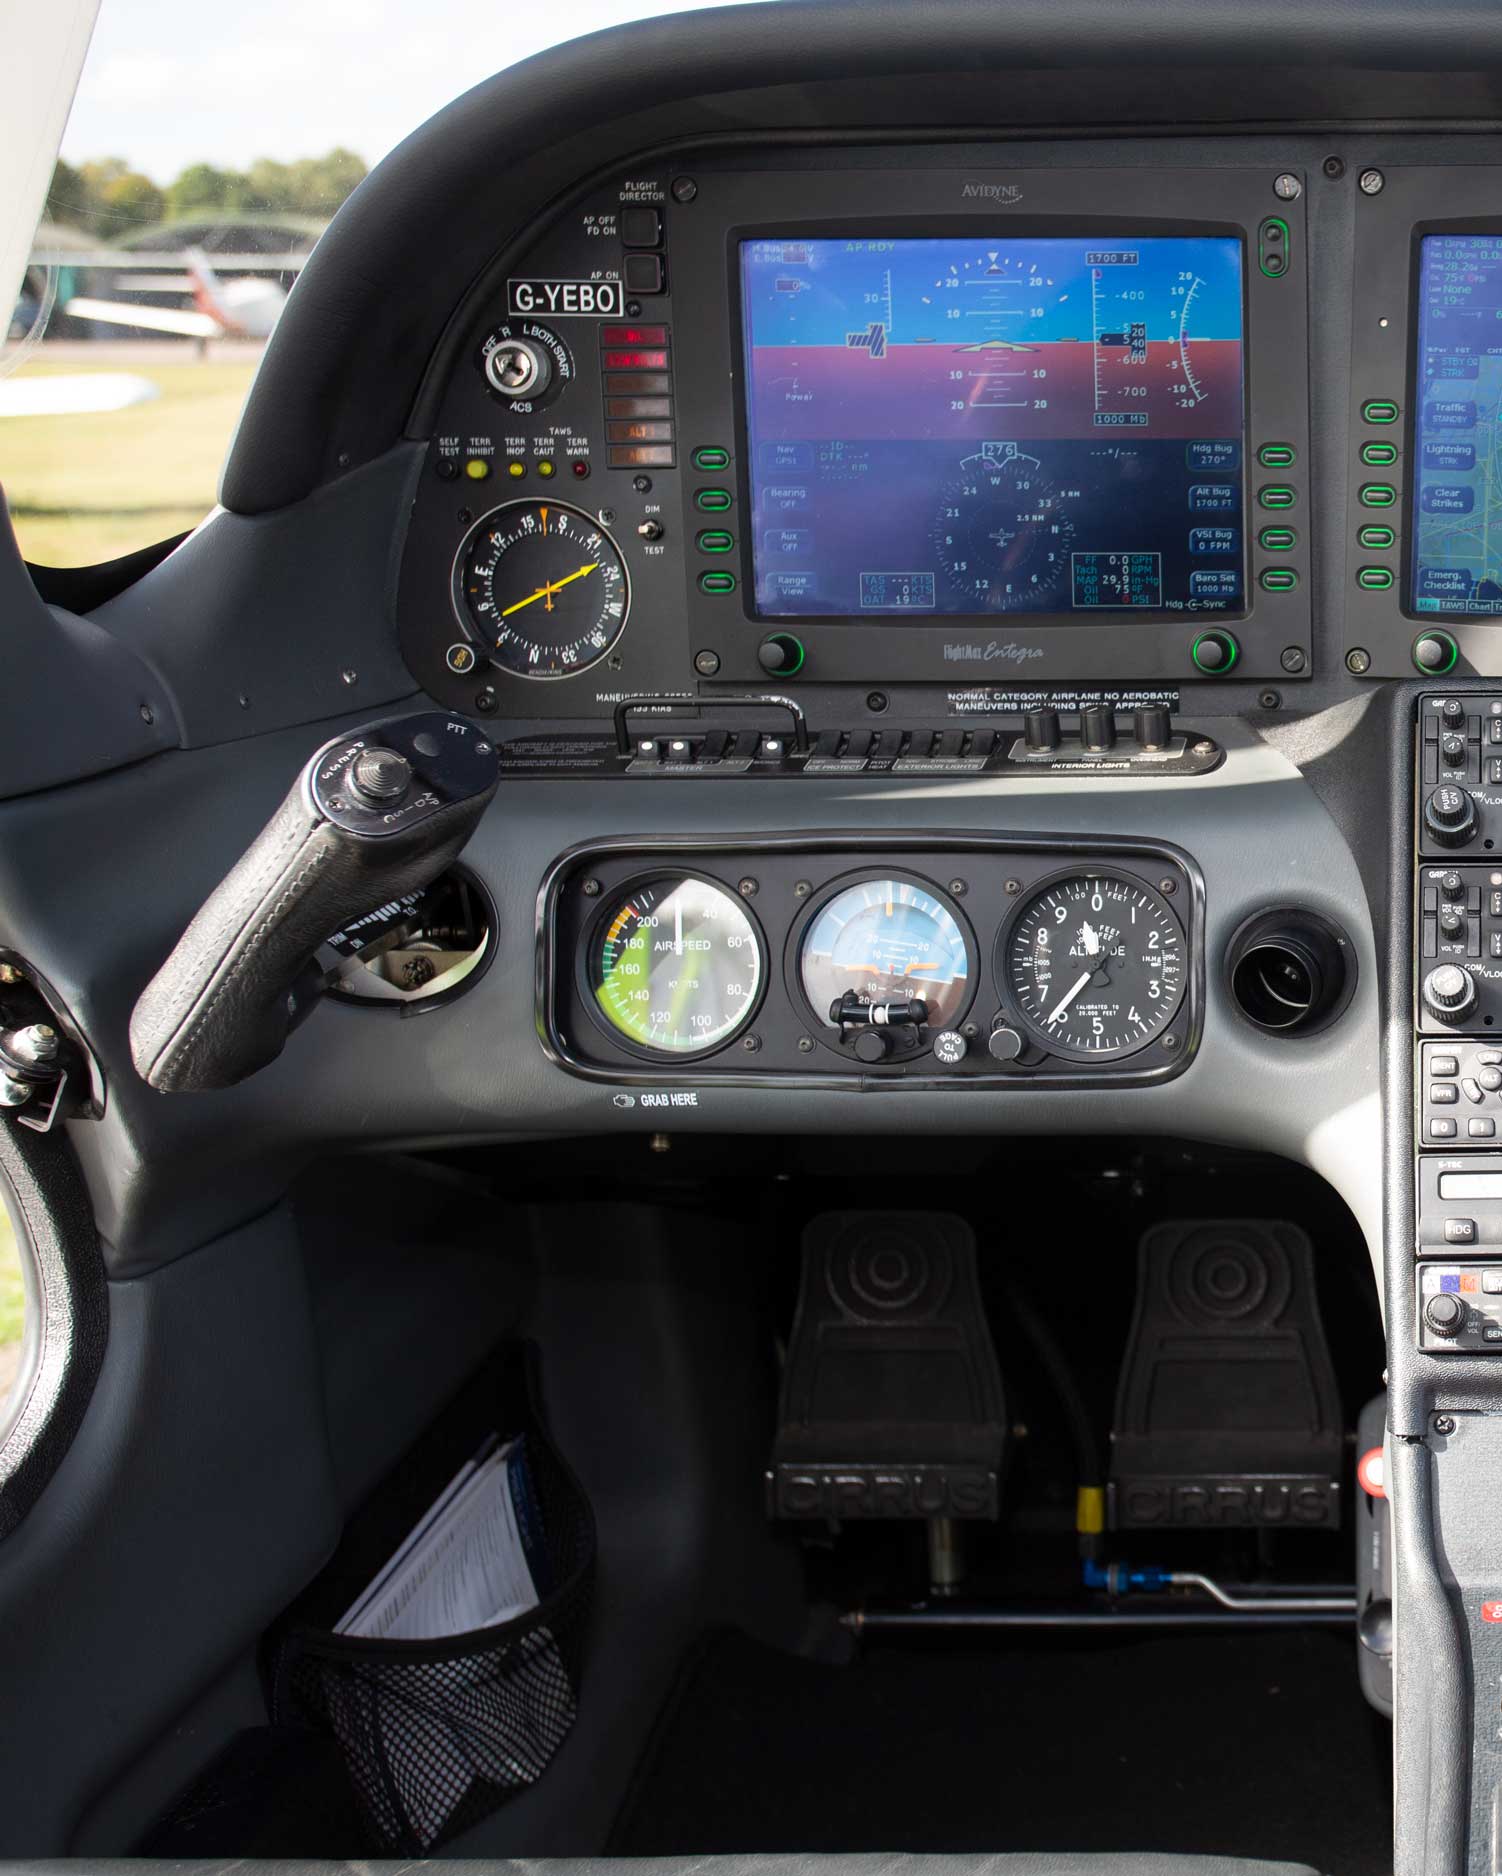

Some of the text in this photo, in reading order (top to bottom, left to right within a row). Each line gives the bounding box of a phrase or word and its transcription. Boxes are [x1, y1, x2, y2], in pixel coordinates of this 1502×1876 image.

[625, 182, 657, 191] FLIGHT
[962, 184, 1019, 198] AVIDYNE
[620, 192, 664, 200] DIRECTOR
[584, 216, 615, 224] AP OFF
[588, 226, 616, 235] FD ON
[1089, 254, 1136, 263] 1700 FT
[591, 271, 618, 280] AP ON
[516, 284, 614, 312] G-YEBO
[482, 325, 570, 378] OFF BOTH START
[1436, 403, 1466, 412] Traffic
[549, 427, 572, 436] TAWS
[440, 438, 459, 446] SELF
[470, 438, 491, 446] TERR
[505, 438, 525, 446] TERR
[534, 438, 554, 446] TERR
[567, 438, 588, 446] TERR
[440, 448, 459, 456] TEST
[467, 447, 495, 455] INHIBIT
[506, 447, 525, 455] INOP
[534, 447, 554, 455] CAUT
[566, 447, 589, 455] WARN
[987, 444, 1013, 456] 276
[1193, 444, 1232, 454] Hdg Bug
[1426, 445, 1471, 456] Lightning
[1197, 488, 1230, 498] Alt Bug
[1436, 488, 1460, 497] Clear
[1432, 499, 1463, 508] Strikes
[645, 505, 660, 513] DIM
[1216, 530, 1232, 540] Bug
[644, 546, 664, 554] TEST
[1196, 574, 1235, 582] Baro Set
[1424, 581, 1466, 590] Checklist
[1166, 600, 1226, 610] Hdg Sync
[1469, 602, 1490, 610] Chart
[948, 693, 990, 701] NORMAL
[1051, 692, 1100, 700] AIRPLANE
[1104, 692, 1118, 700] NO
[1122, 692, 1179, 700] AEROBATIC
[447, 723, 468, 735] PTT
[637, 917, 658, 927] 200
[623, 938, 644, 949] 180
[728, 937, 742, 947] 60
[620, 964, 639, 975] 160
[727, 984, 742, 995] 80
[629, 990, 649, 1000] 140
[650, 1012, 671, 1023] 120
[691, 1016, 711, 1026] 100
[641, 1093, 697, 1106] GRAB HERE
